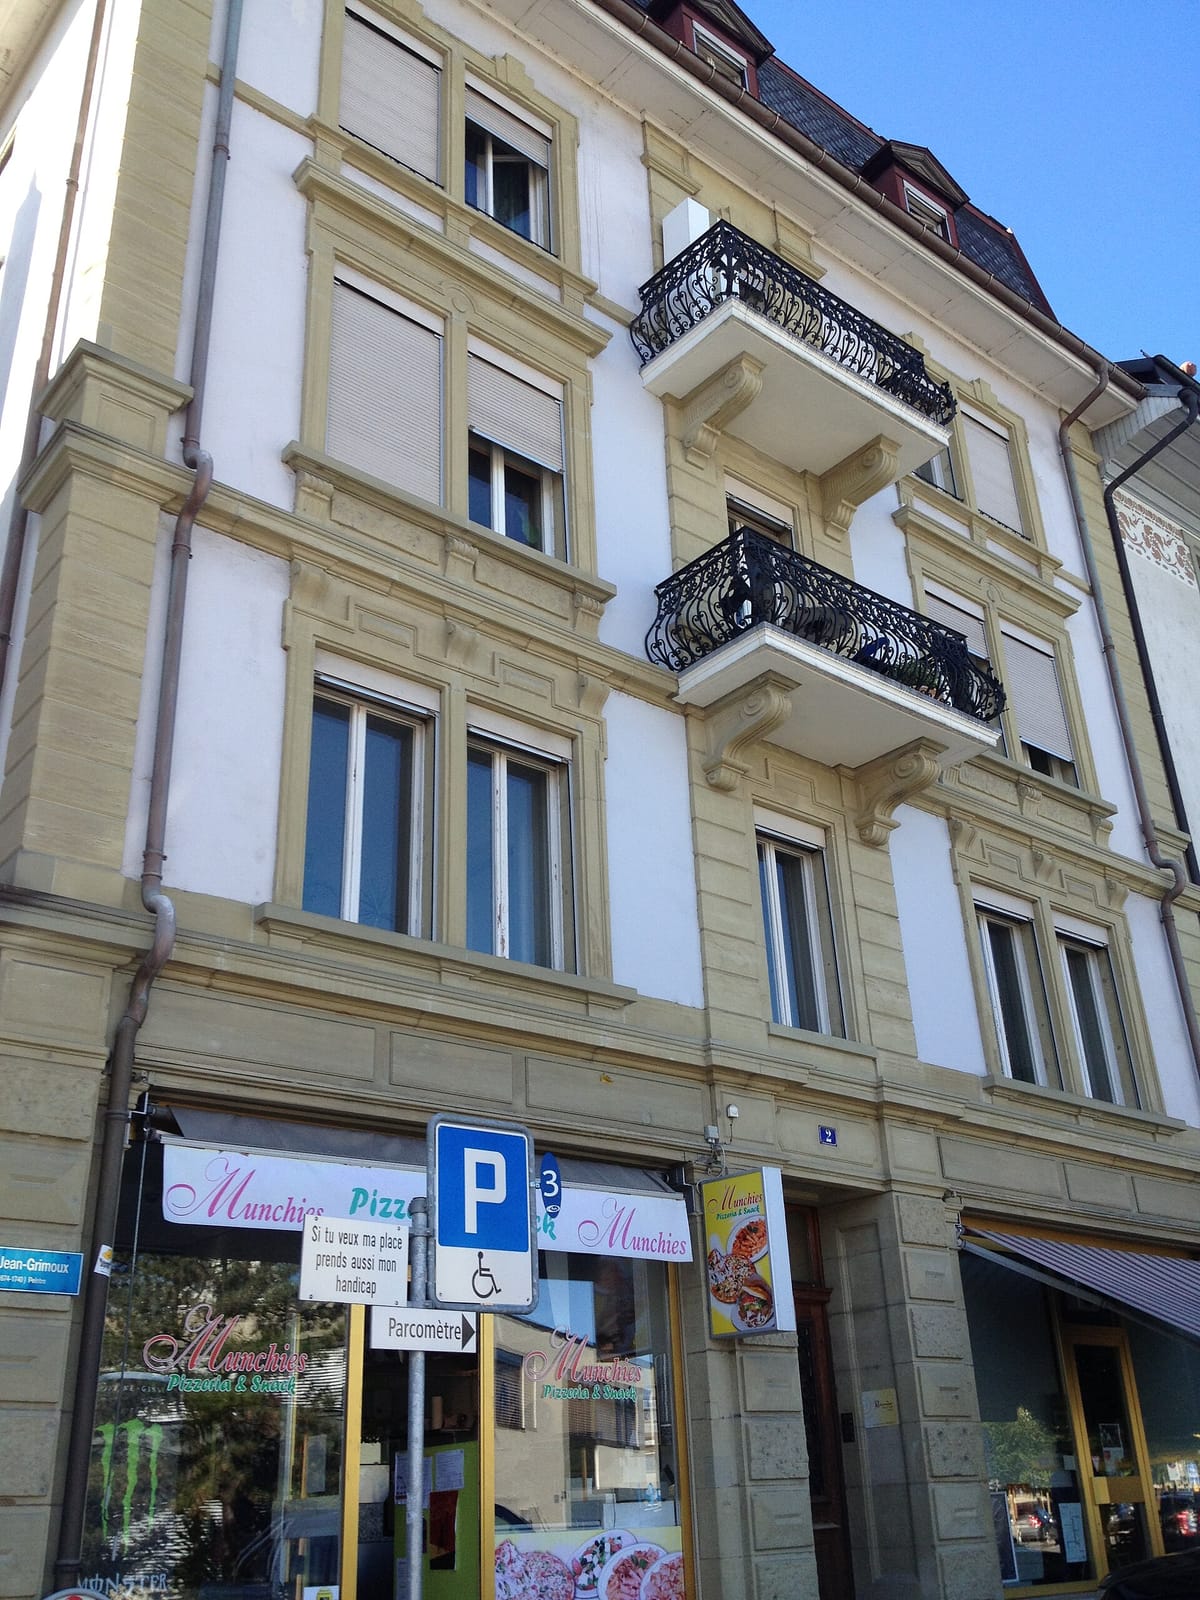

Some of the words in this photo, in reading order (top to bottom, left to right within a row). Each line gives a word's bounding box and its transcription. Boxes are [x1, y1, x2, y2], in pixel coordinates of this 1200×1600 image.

[825, 1128, 832, 1143] 2
[463, 1147, 507, 1234] P
[542, 1169, 559, 1197] 3
[349, 1187, 413, 1219] Pizz
[707, 1183, 763, 1214] Munchies
[311, 1225, 321, 1242] Si
[325, 1227, 335, 1243] tu
[338, 1231, 359, 1246] veux
[362, 1234, 377, 1247] ma
[380, 1232, 403, 1252] place
[577, 1196, 687, 1255] Munchies
[315, 1251, 348, 1271] prends
[351, 1254, 375, 1271] aussi
[378, 1258, 397, 1273] mon
[335, 1274, 377, 1299] handicap
[143, 1303, 308, 1372] Munchies
[388, 1317, 462, 1340] Parcomètre
[524, 1325, 642, 1383] Munchies
[167, 1373, 232, 1393] Pizzeria
[234, 1375, 247, 1393] &
[250, 1376, 296, 1395] Snack
[543, 1384, 589, 1400] Pizzeria
[603, 1385, 637, 1402] Snack
